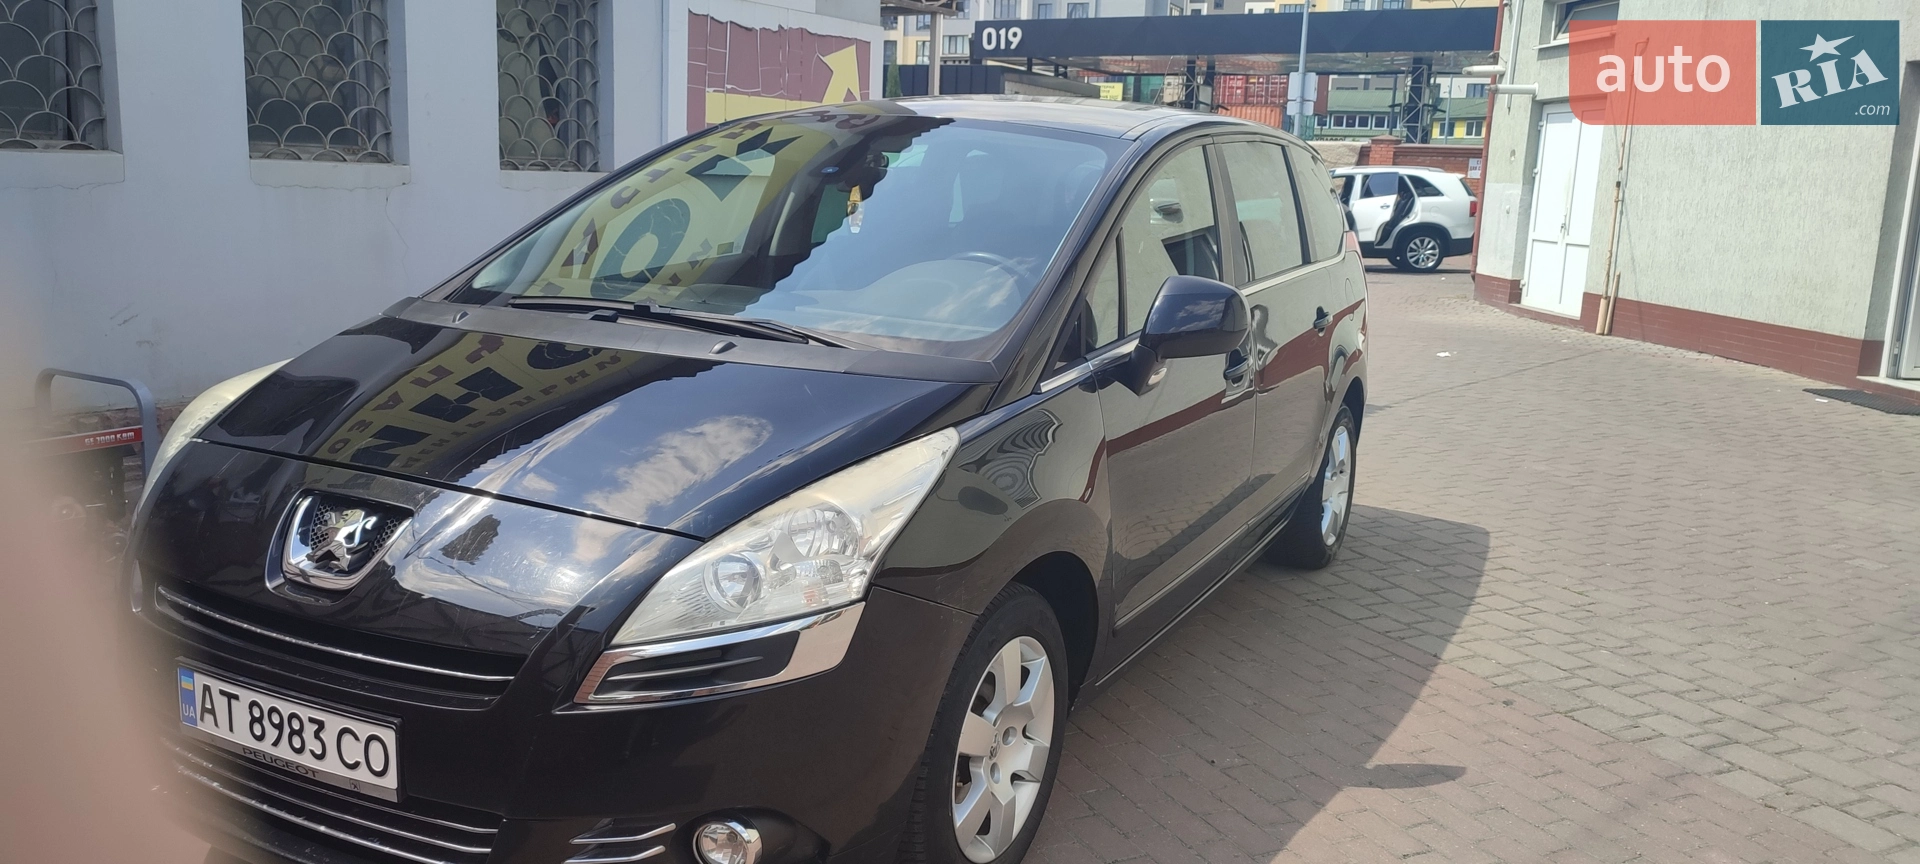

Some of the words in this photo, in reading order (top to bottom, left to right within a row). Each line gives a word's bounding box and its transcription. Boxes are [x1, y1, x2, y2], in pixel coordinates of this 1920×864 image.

[982, 26, 1023, 51] 019
[95, 434, 116, 444] 7000
[182, 702, 196, 719] UA
[199, 681, 240, 734] AT
[248, 698, 327, 761] 8983
[336, 726, 390, 778] CO
[241, 746, 320, 779] PEUGEOT
